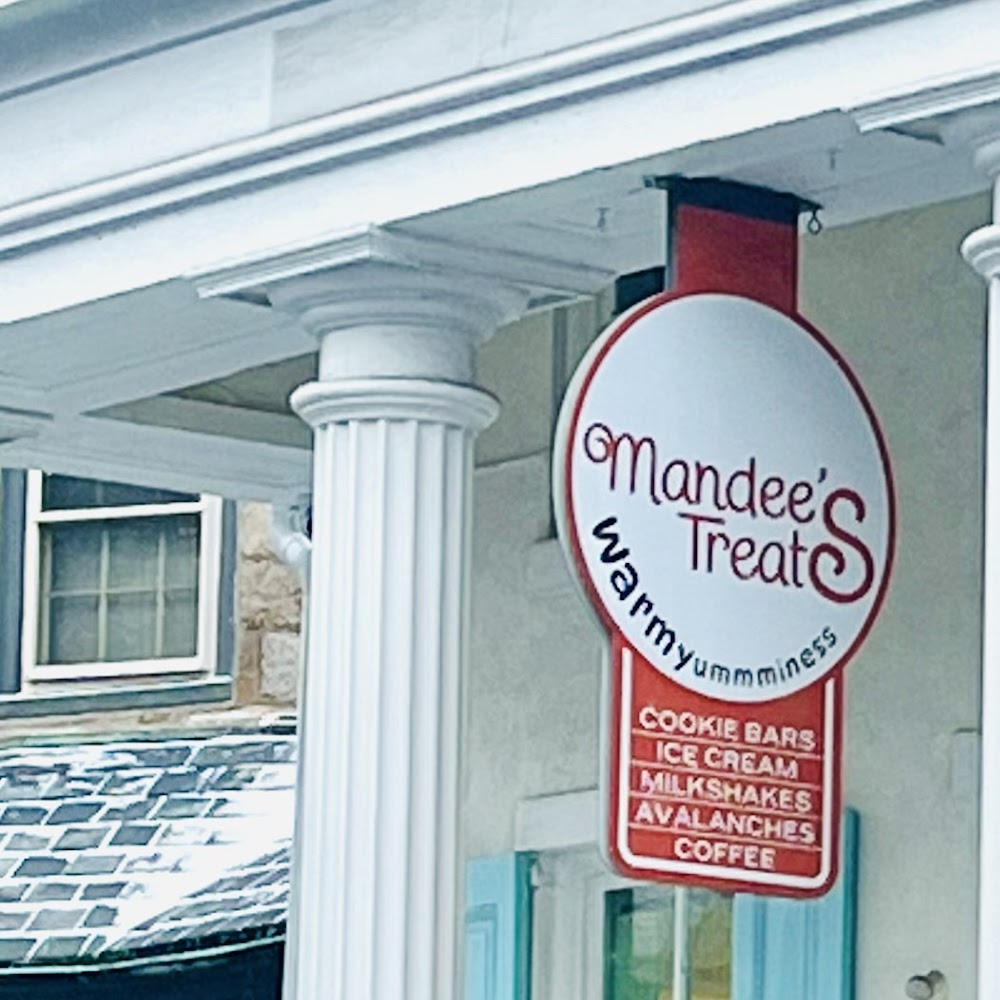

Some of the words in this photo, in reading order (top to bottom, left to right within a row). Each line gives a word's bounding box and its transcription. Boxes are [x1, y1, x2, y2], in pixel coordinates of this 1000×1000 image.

[639, 706, 738, 742] COOKIE
[744, 722, 816, 750] BARS
[656, 741, 699, 769] ICE
[704, 747, 798, 779] CREAM
[640, 770, 812, 812] MILKSHAKES
[635, 801, 816, 844] AVALANCHES
[673, 837, 776, 870] COFFEE
